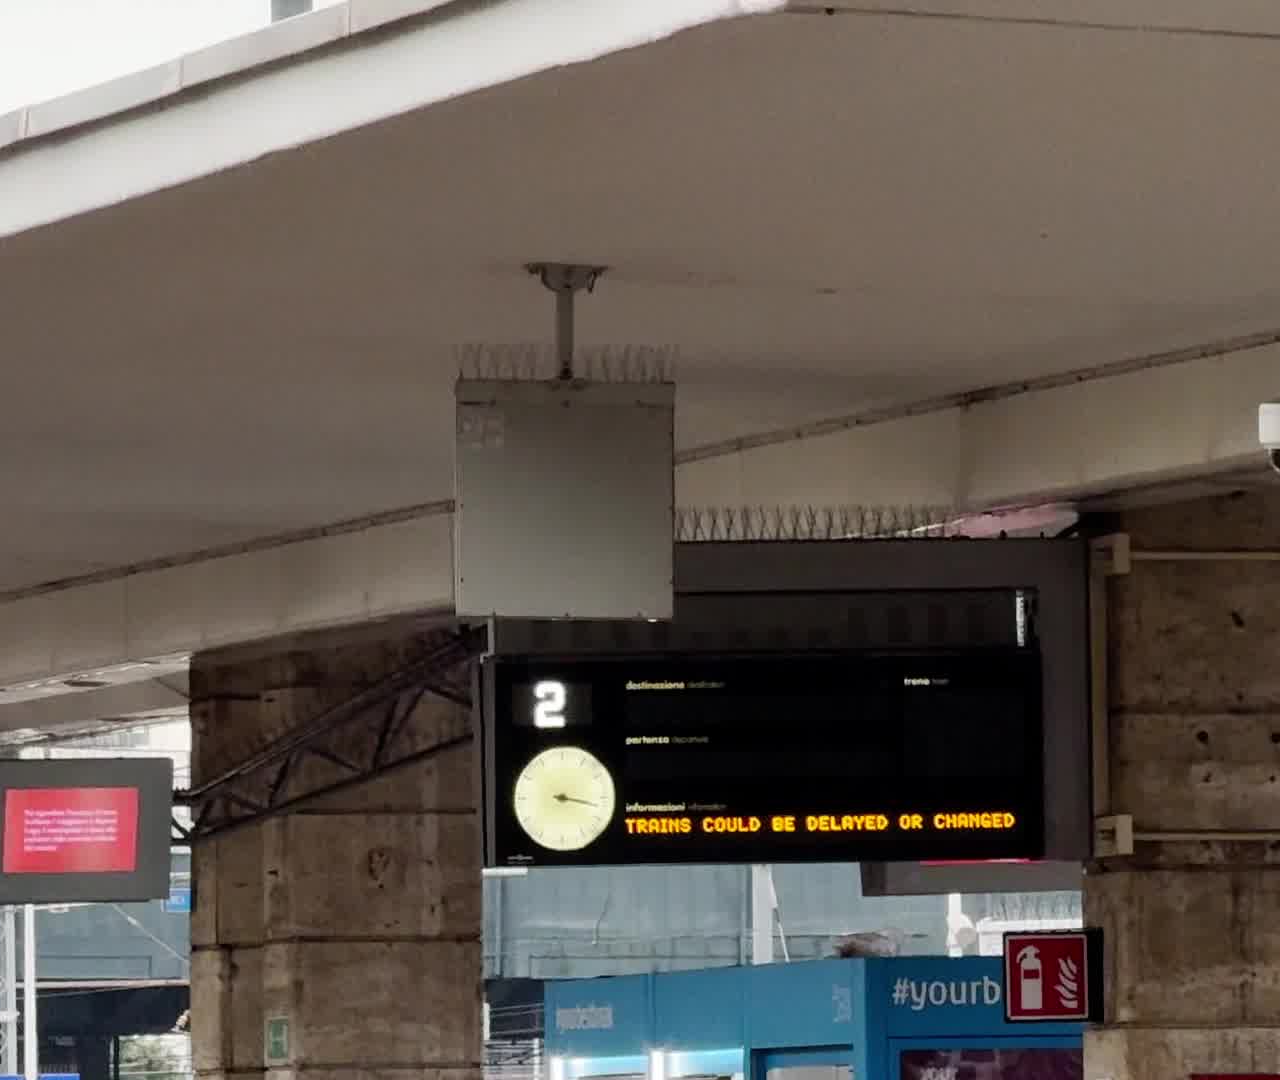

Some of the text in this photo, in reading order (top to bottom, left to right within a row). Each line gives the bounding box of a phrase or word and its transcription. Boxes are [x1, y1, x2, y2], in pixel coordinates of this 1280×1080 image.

[625, 680, 686, 690] destinazione
[903, 677, 931, 686] treno
[533, 680, 567, 729] 2
[625, 801, 687, 813] informazioni
[624, 811, 1016, 834] TRAINS COULD BE DELAYED OR CHANGED
